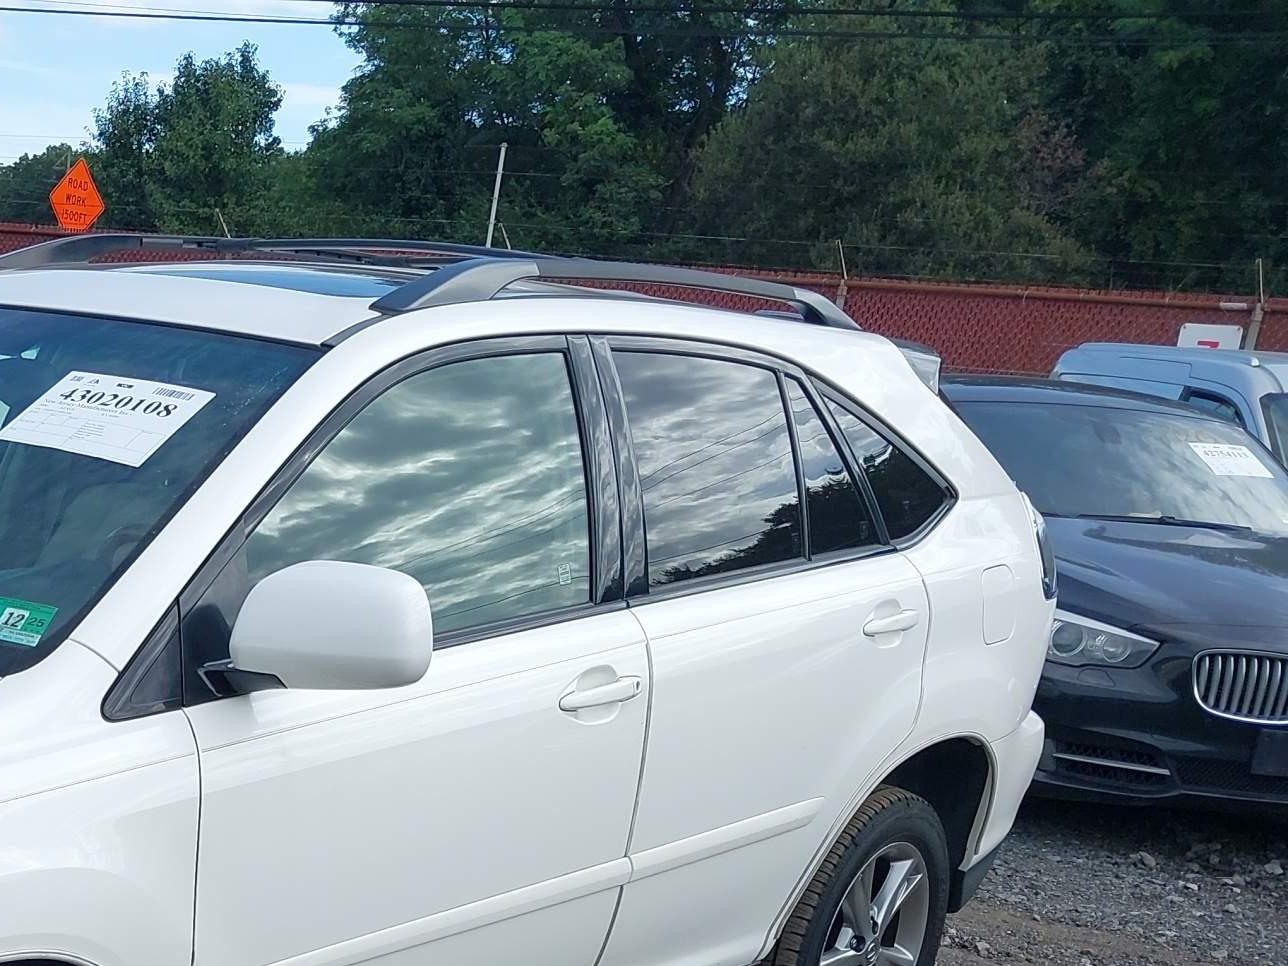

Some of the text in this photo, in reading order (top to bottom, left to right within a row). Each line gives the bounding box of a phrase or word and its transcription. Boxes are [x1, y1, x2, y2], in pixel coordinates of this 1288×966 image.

[67, 177, 89, 192] ROAD
[65, 193, 87, 208] WORK
[59, 388, 179, 418] 43020108
[1, 611, 26, 628] 12
[26, 617, 47, 628] 25
